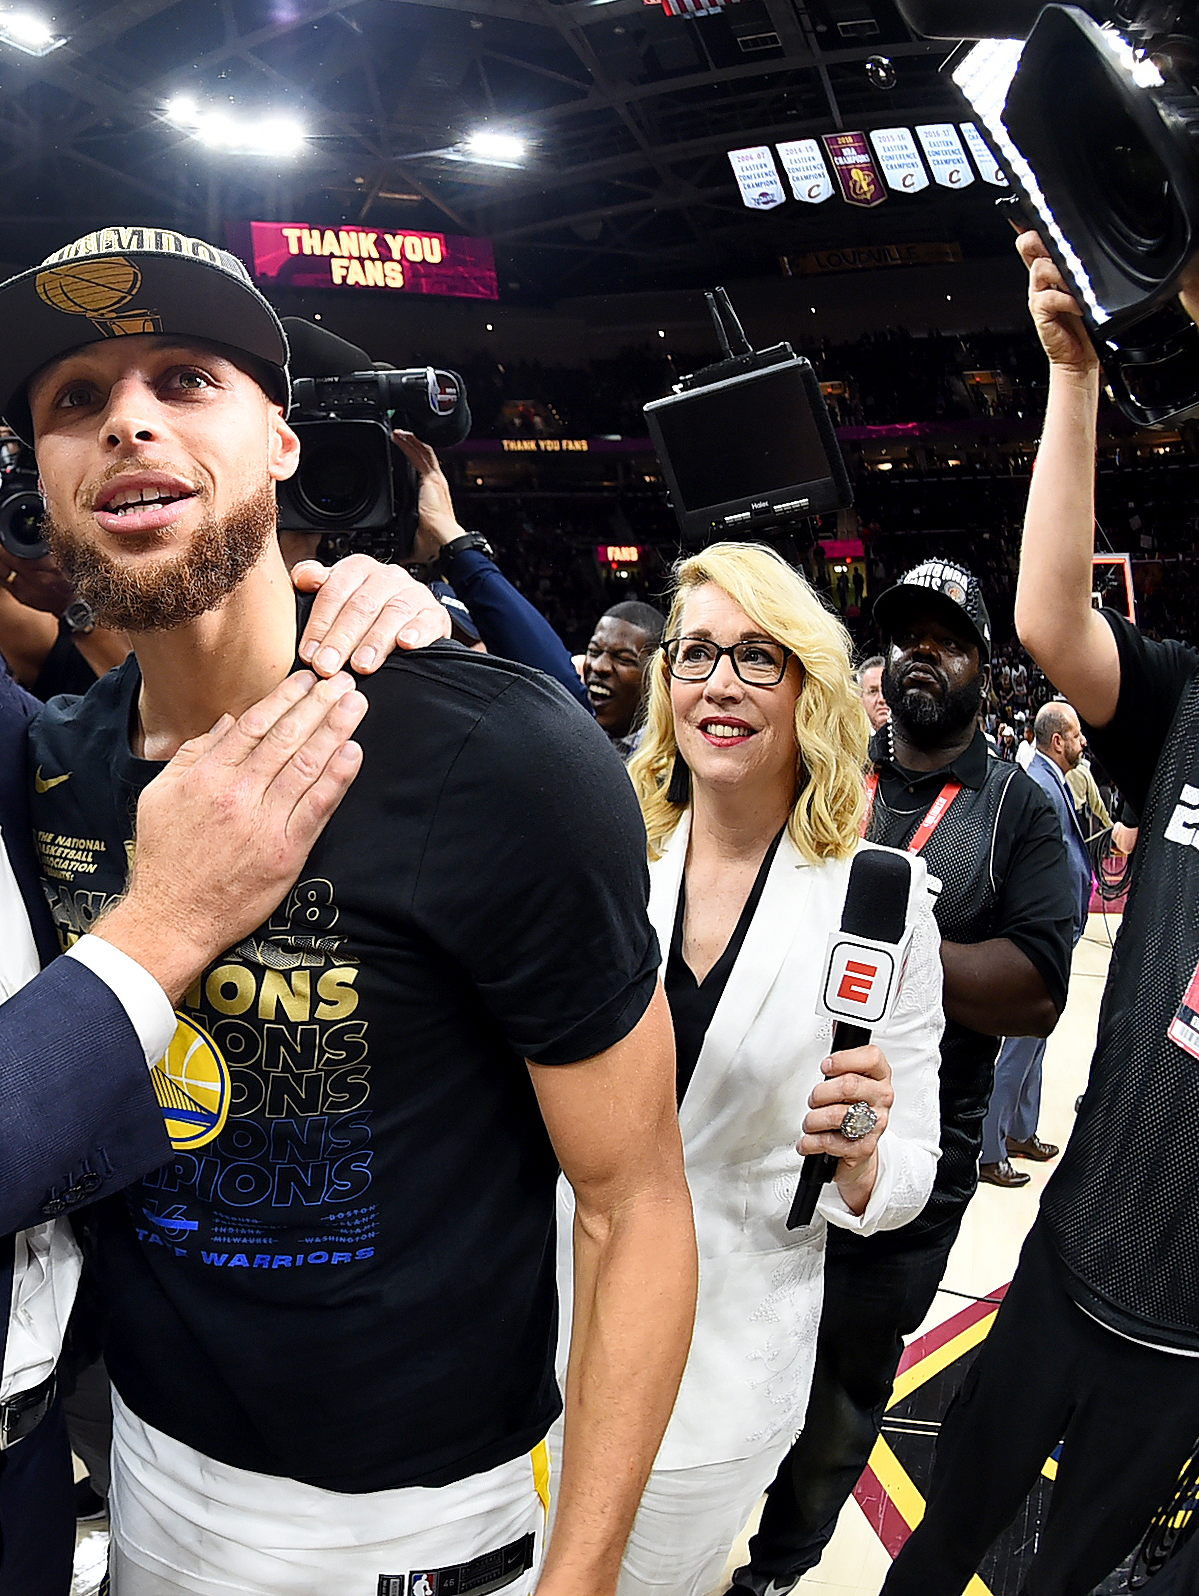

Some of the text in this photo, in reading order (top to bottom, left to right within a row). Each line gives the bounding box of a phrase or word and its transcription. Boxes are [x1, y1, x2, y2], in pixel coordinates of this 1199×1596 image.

[882, 144, 909, 153] EASTERN
[928, 140, 954, 148] EASTERN
[881, 152, 917, 162] CONFERENCE
[928, 148, 962, 157] CONFERENCE
[789, 155, 816, 165] EASTERN
[834, 153, 871, 166] CHAMPIONS
[932, 157, 965, 167] CHAMPIONS
[741, 162, 768, 173] EASTERN
[787, 163, 824, 174] CONFERENCE
[885, 161, 919, 171] CHAMPIONS
[738, 170, 776, 182] CONFERENCE
[791, 172, 826, 183] CHAMPIONS
[743, 179, 778, 190] CHAMPIONS
[282, 228, 380, 259] THANK
[384, 233, 443, 264] YOU
[330, 257, 405, 289] FANS
[502, 439, 589, 452] THANK YOU FANS
[606, 546, 639, 562] FANS
[38, 831, 107, 852] THE NATIONAL
[837, 960, 878, 1004] E
[328, 1204, 377, 1221] BOSTON
[214, 1226, 262, 1235] INDIANA
[213, 1235, 274, 1245] MILWAUKEE
[304, 1231, 377, 1244] WASHINGTON
[200, 1246, 376, 1269] WARRIORS
